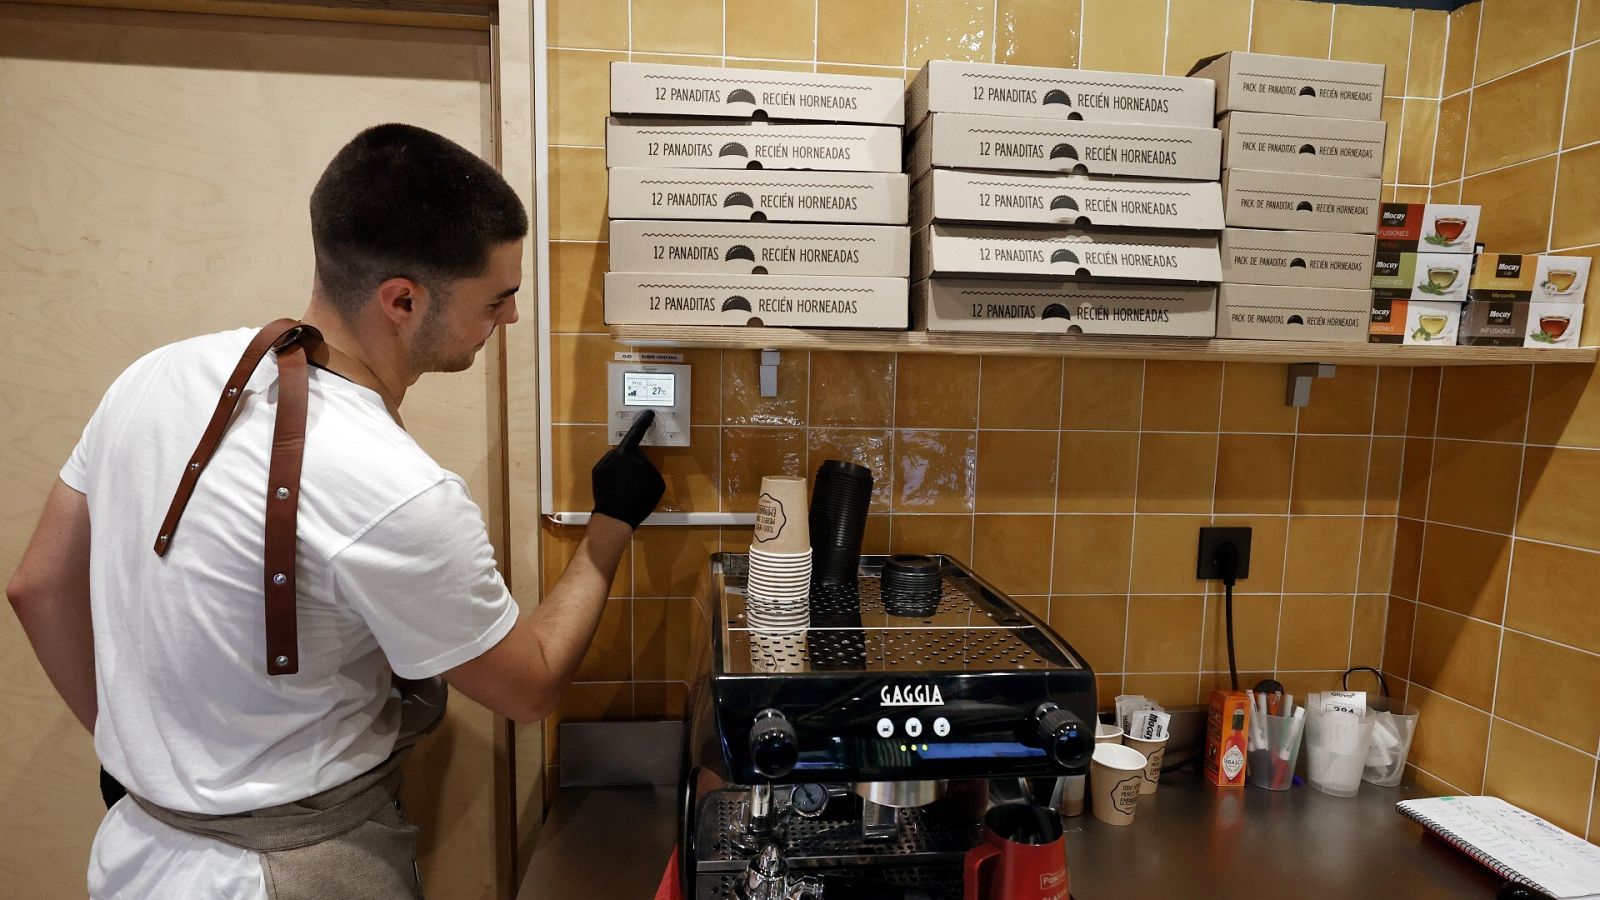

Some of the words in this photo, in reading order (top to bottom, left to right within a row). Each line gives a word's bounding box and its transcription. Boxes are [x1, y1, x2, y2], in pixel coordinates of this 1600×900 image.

[656, 87, 666, 100] 12
[671, 88, 720, 102] PANADITAS
[763, 91, 795, 106] RECIÉN
[800, 95, 857, 109] HORNEADAS
[974, 87, 984, 100] 12
[989, 88, 1037, 104] PANADITAS
[1078, 93, 1109, 108] RECIÉN
[1114, 96, 1168, 113] HORNEADAS
[1243, 83, 1256, 92] PACK
[1259, 84, 1266, 93] DE
[1268, 85, 1296, 95] PANADITAS
[1320, 88, 1338, 98] RECIÉN
[1340, 91, 1372, 101] HORNEADAS
[649, 143, 658, 155] 12
[664, 143, 712, 156] PANADITAS
[756, 143, 788, 157] RECIÉN
[793, 146, 850, 159] HORNEADAS
[980, 142, 990, 155] 12
[995, 143, 1043, 158] PANADITAS
[1086, 145, 1117, 161] RECIÉN
[1122, 149, 1176, 165] HORNEADAS
[1243, 142, 1256, 150] PACK
[1259, 143, 1265, 151] DE
[1268, 143, 1295, 153] PANADITAS
[1320, 145, 1338, 155] RECIÉN
[1340, 148, 1372, 158] HORNEADAS
[653, 193, 662, 205] 12
[668, 193, 717, 206] PANADITAS
[761, 193, 793, 208] RECIÉN
[799, 196, 857, 210] HORNEADAS
[980, 194, 990, 206] 12
[995, 195, 1043, 209] PANADITAS
[1086, 198, 1117, 212] RECIÉN
[1121, 201, 1177, 215] HORNEADAS
[1241, 199, 1254, 207] PACK
[1257, 200, 1263, 208] DE
[1266, 201, 1293, 210] PANADITAS
[1316, 202, 1334, 213] RECIÉN
[1337, 205, 1368, 215] HORNEADAS
[1383, 211, 1405, 220] Mocay
[654, 246, 664, 259] 12
[669, 246, 718, 260] PANADITAS
[762, 246, 795, 261] RECIÉN
[800, 249, 858, 263] HORNEADAS
[981, 248, 990, 260] 12
[995, 249, 1044, 262] PANADITAS
[1085, 251, 1117, 265] RECIÉN
[1121, 254, 1177, 268] HORNEADAS
[1235, 256, 1247, 264] PACK
[1251, 257, 1257, 265] DE
[1260, 258, 1287, 267] PANADITAS
[1310, 259, 1328, 269] RECIÉN
[1330, 261, 1362, 271] HORNEADAS
[1376, 261, 1398, 270] Mocay
[1498, 263, 1520, 272] Mocay
[650, 297, 660, 310] 12
[665, 297, 715, 311] PANADITAS
[759, 297, 792, 312] RECIÉN
[797, 300, 857, 313] HORNEADAS
[973, 304, 982, 317] 12
[987, 304, 1035, 318] PANADITAS
[1077, 305, 1109, 320] RECIÉN
[1114, 308, 1169, 322] HORNEADAS
[1232, 314, 1245, 322] PACK
[1248, 315, 1254, 323] DE
[1257, 315, 1284, 324] PANADITAS
[1307, 315, 1325, 325] RECIÉN
[1327, 318, 1359, 327] HORNEADAS
[1490, 310, 1511, 319] Mocay
[880, 684, 944, 706] GAGGIA
[1143, 713, 1158, 740] Mocay
